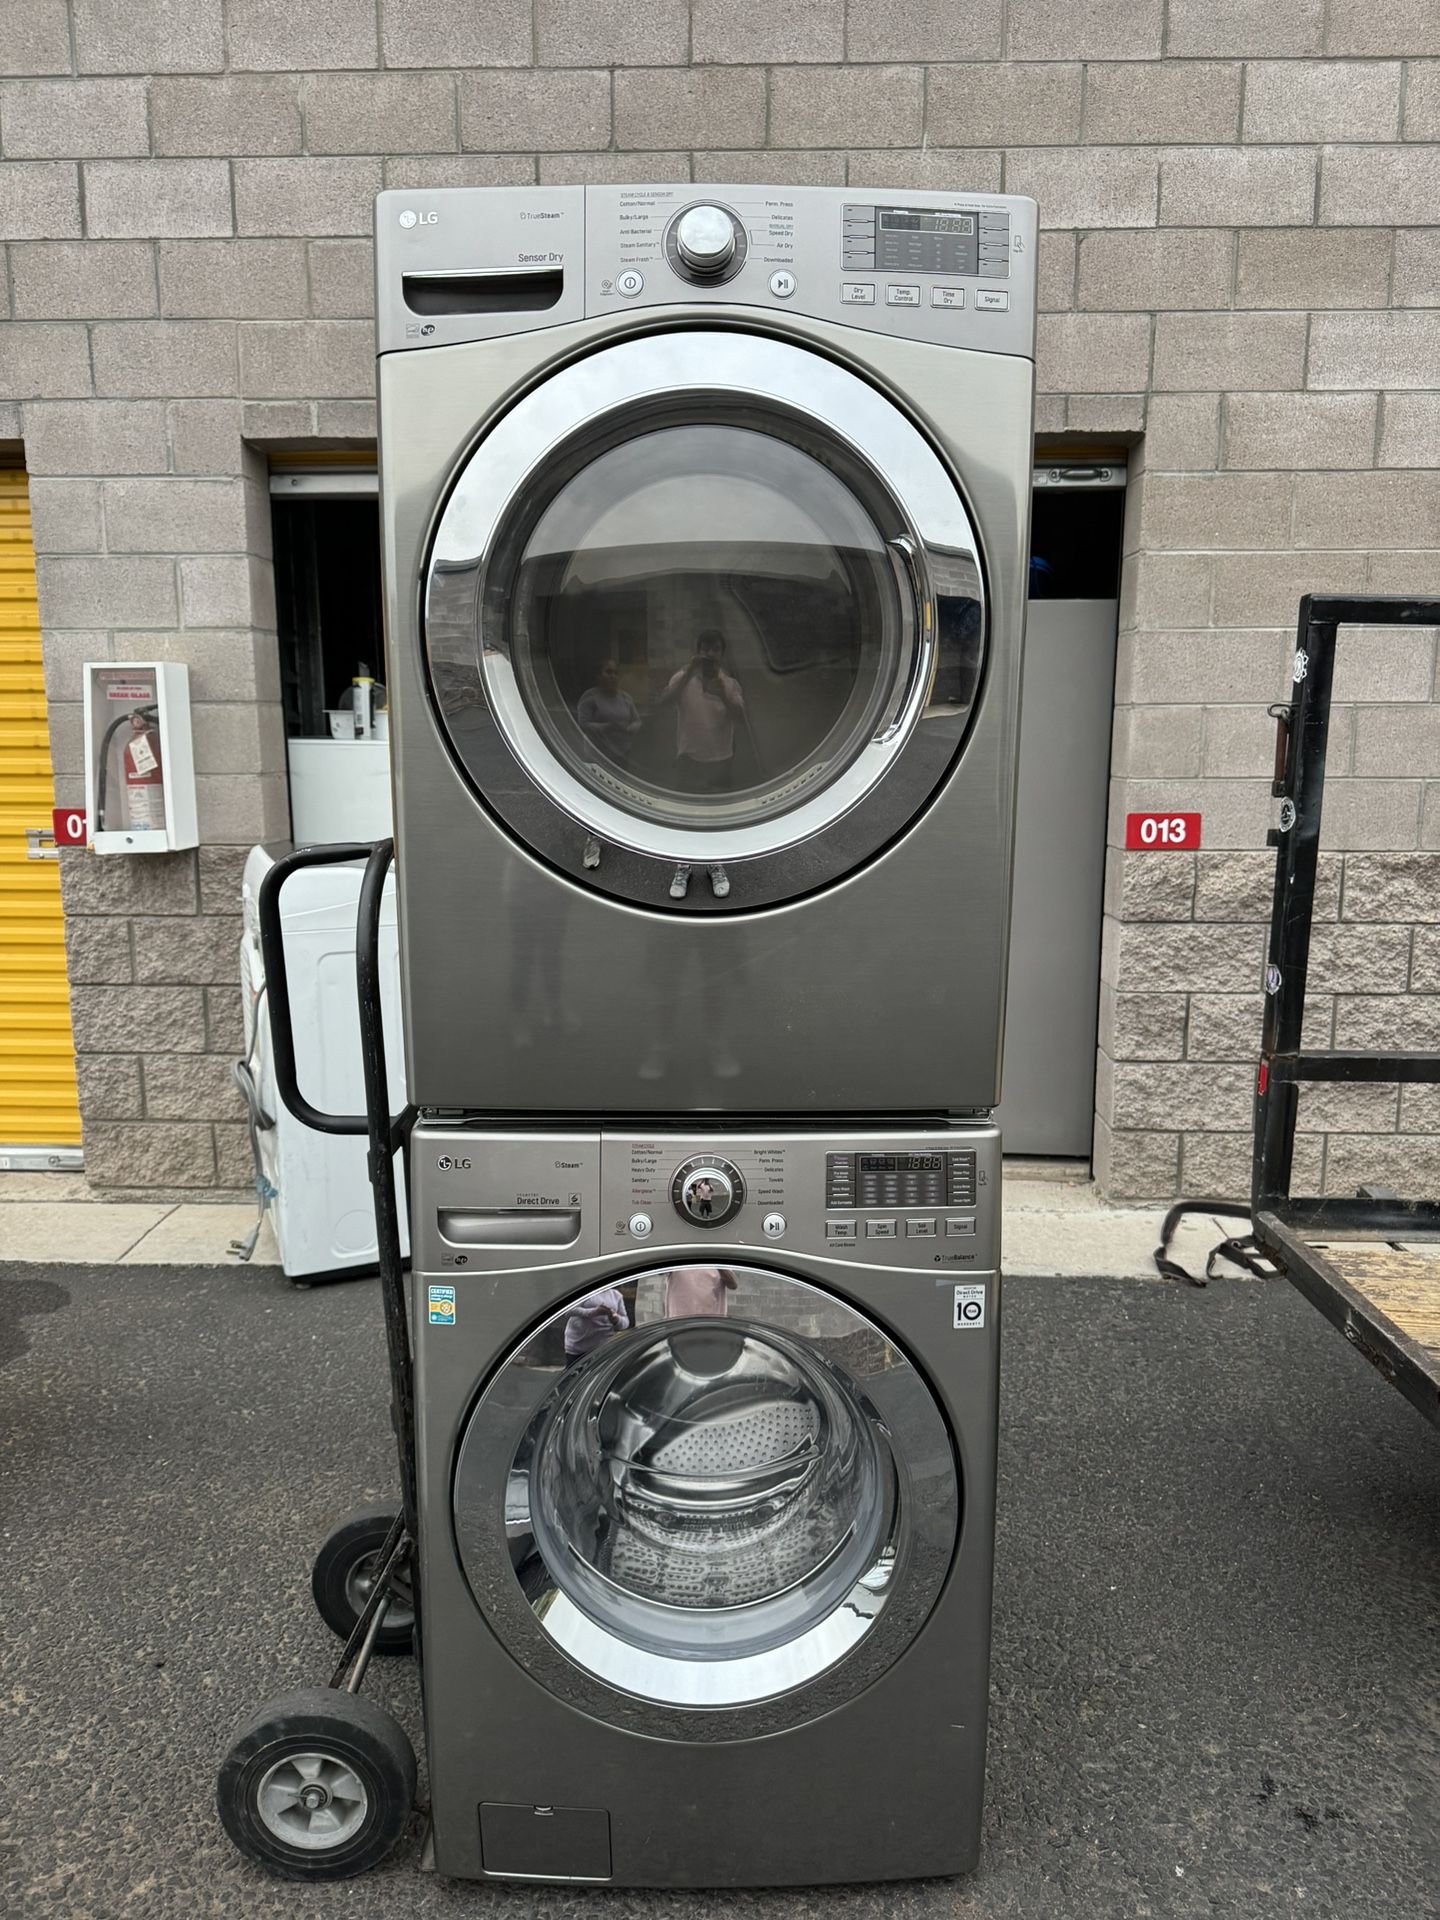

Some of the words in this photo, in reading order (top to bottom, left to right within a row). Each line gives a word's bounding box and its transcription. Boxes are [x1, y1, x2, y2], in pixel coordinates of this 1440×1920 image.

[419, 211, 438, 225] LG
[518, 253, 547, 263] Sensor
[549, 252, 564, 262] Dry
[942, 290, 955, 298] Time
[984, 296, 1000, 304] Signal
[1140, 817, 1187, 844] 013
[454, 1158, 471, 1169] LG
[516, 1196, 540, 1205] Direct
[540, 1196, 560, 1205] Drive
[957, 1301, 983, 1321] 10
